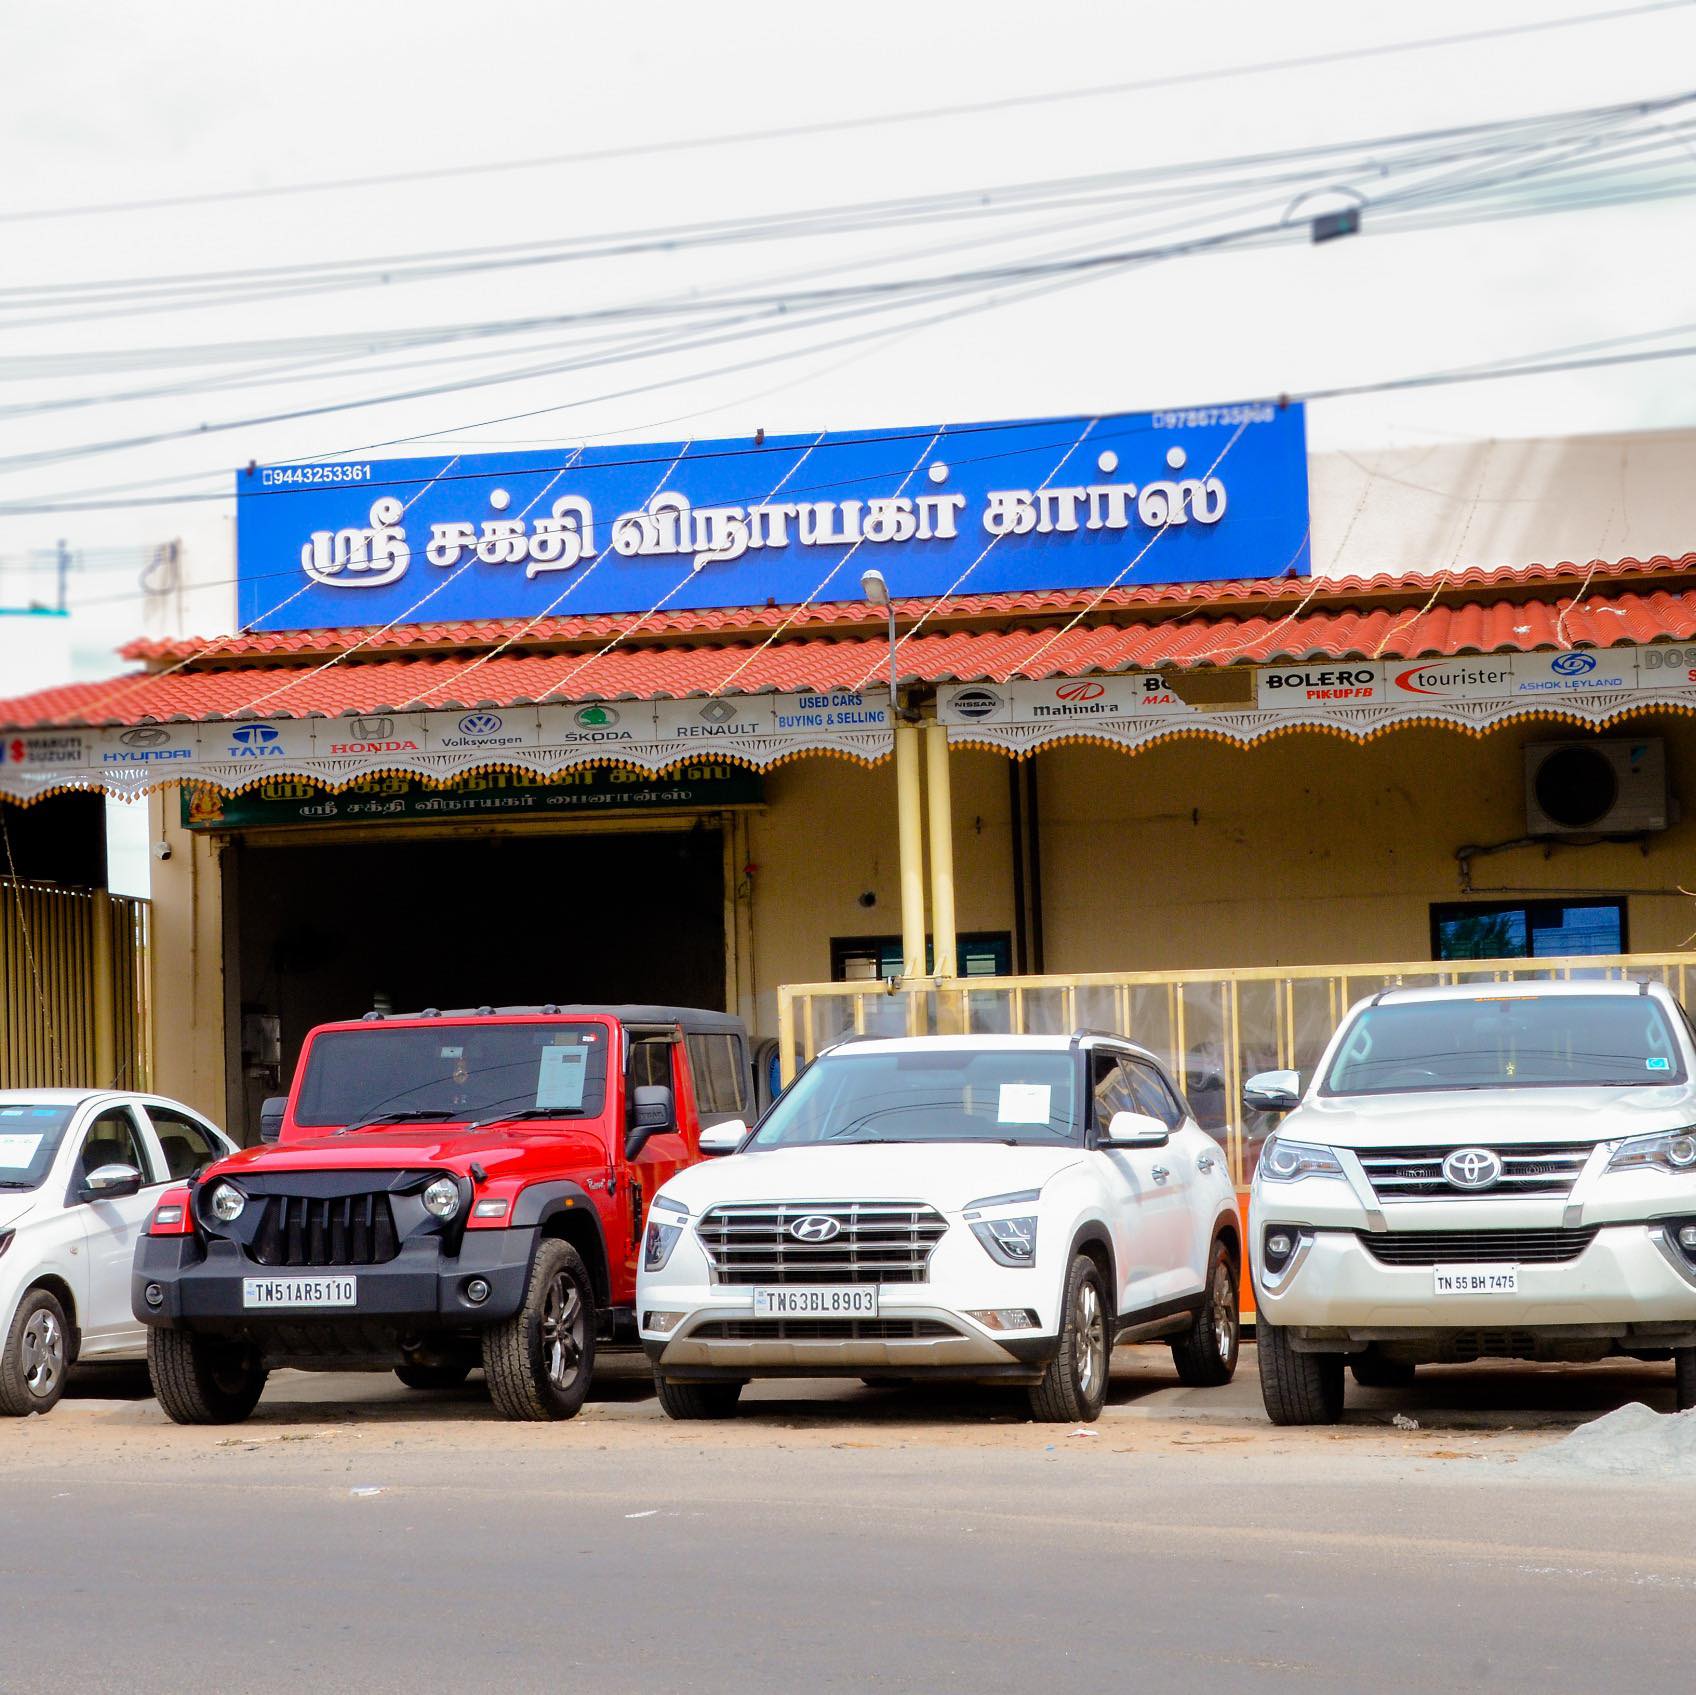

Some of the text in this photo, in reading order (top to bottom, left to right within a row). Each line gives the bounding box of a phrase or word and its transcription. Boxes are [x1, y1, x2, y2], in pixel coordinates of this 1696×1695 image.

[273, 465, 371, 484] 9443253361
[301, 450, 1227, 588] ஸ்ரீ சக்தி விநாயகர் கார்ஸ்
[1266, 669, 1375, 689] BOLERO
[1417, 669, 1508, 688] tourister
[1519, 678, 1623, 691] ASHOK LEYLAND
[799, 694, 863, 709] USED CARS
[954, 700, 997, 708] NISSAN
[1033, 702, 1119, 717] Mahindra
[778, 711, 885, 728] BUYING & SELLING
[677, 723, 759, 737] RENAULT
[330, 740, 419, 754] HONDA
[442, 736, 522, 748] Volkswagen
[103, 749, 192, 762] HYUNDAI
[228, 745, 286, 757] TATA
[1438, 1275, 1515, 1290] TN 55 BH 7475
[255, 1282, 352, 1302] TN51AR5110
[766, 1292, 873, 1312] TN63BL8903
